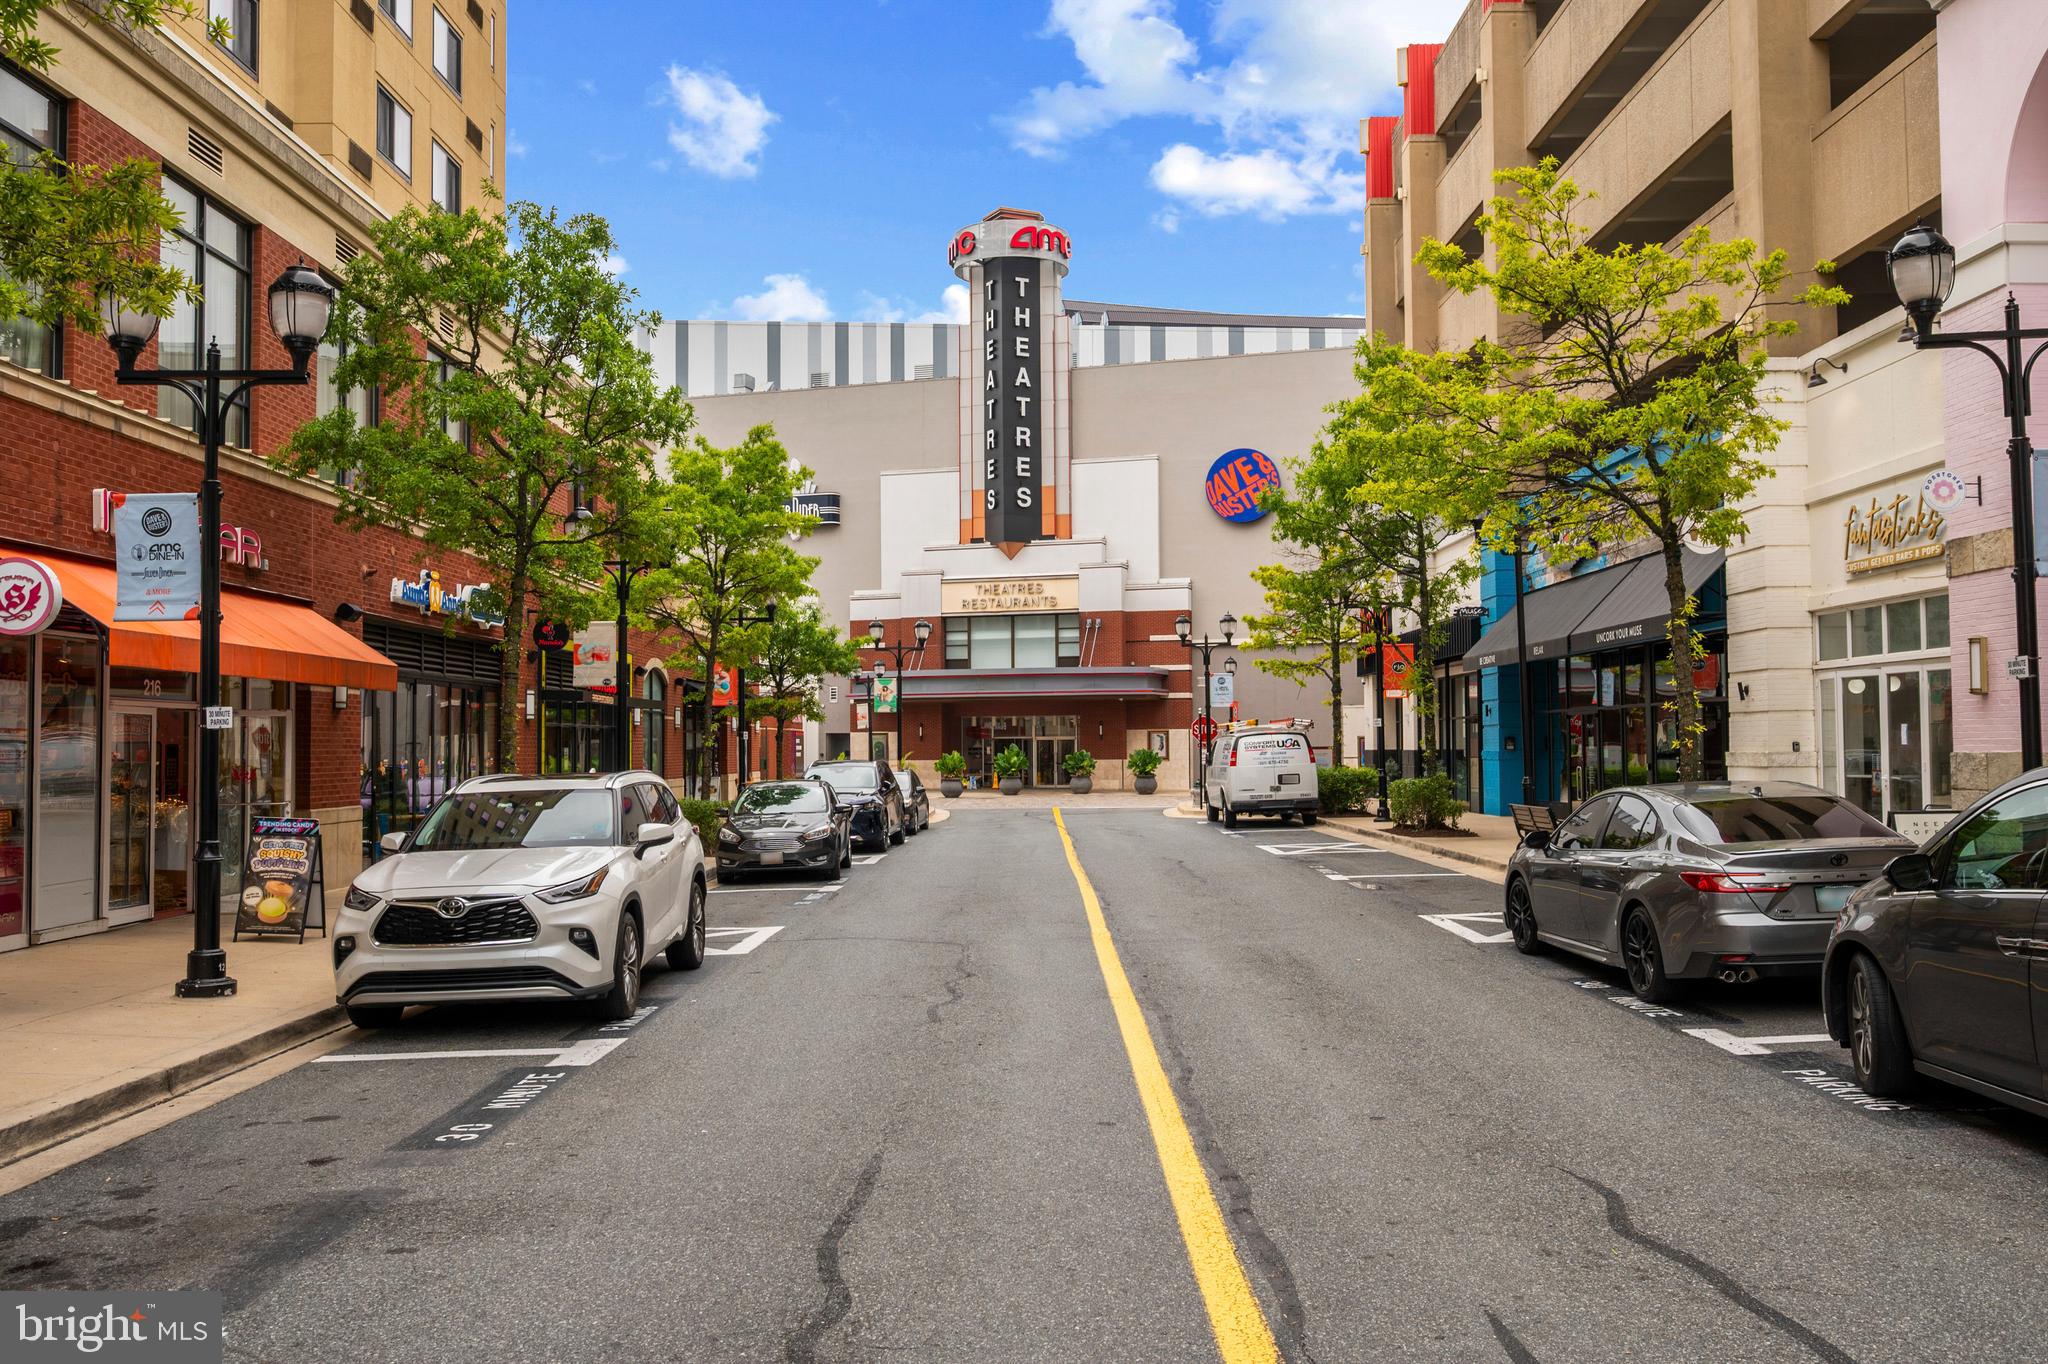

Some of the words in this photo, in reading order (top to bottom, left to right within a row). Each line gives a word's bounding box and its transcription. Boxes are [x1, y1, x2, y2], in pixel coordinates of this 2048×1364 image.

[985, 279, 995, 510] THEATRES
[1014, 276, 1032, 508] THEATRES
[1206, 456, 1260, 505] DAVE
[1252, 452, 1275, 475] &
[148, 551, 185, 561] DINE-IN
[1847, 560, 1869, 572] CUSTOM
[1871, 554, 1894, 566] GELATO
[1896, 550, 1913, 561] BARS
[1922, 544, 1940, 556] POPS
[975, 583, 1044, 596] THEATRES
[961, 596, 1058, 610] RESTAURANTS
[1595, 631, 1615, 643] UNCORK
[1615, 627, 1629, 640] YOUR
[1629, 624, 1643, 637] MUSE
[143, 679, 161, 697] 216
[208, 710, 214, 718] 30
[215, 710, 231, 718] MINUTE
[210, 718, 229, 726] PARKING
[1276, 738, 1301, 749] USA
[259, 820, 290, 828] TRENDING
[292, 821, 314, 829] CANDY
[259, 848, 305, 860] SQUISHY
[253, 857, 307, 872] DUMPLING
[1781, 1069, 1911, 1111] PARKING
[435, 1122, 494, 1142] 30
[481, 1072, 567, 1110] MINUTE
